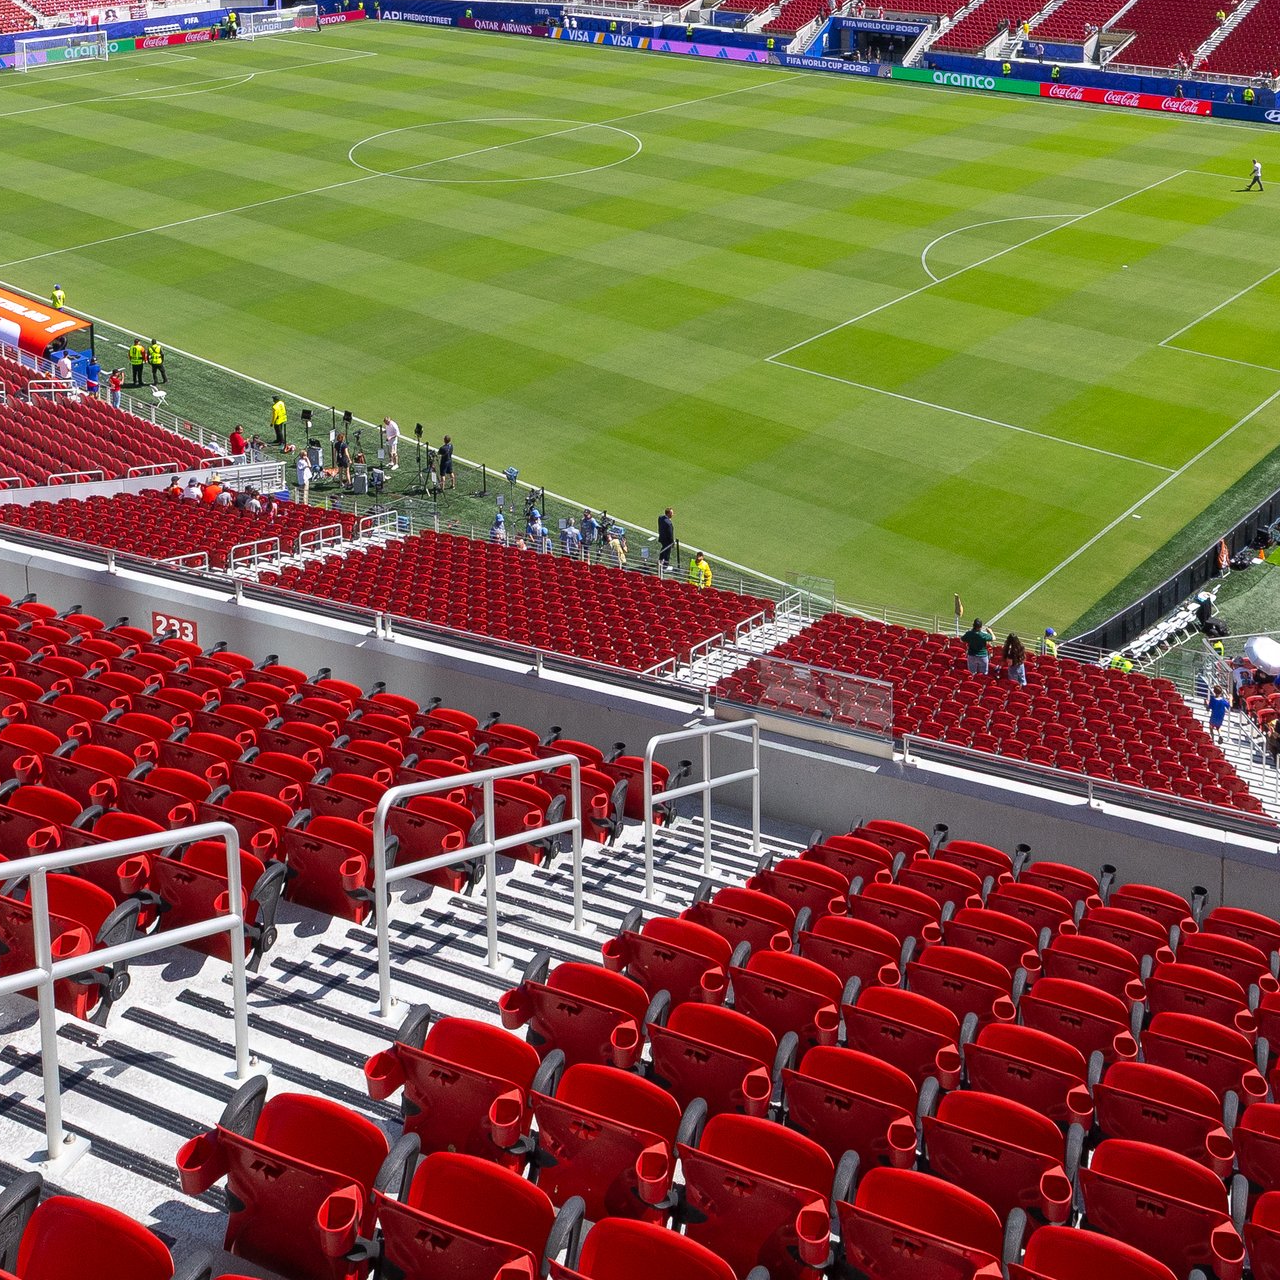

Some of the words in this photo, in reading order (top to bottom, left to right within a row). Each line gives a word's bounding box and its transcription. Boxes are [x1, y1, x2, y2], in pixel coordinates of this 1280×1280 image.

[314, 14, 346, 25] enovo
[383, 10, 401, 20] ADI
[403, 12, 452, 25] PREDICTSTREET
[474, 19, 499, 31] QATAR
[501, 22, 533, 35] AIRWAYS
[842, 19, 856, 28] FIFA
[857, 20, 880, 30] WORLD
[881, 22, 895, 32] CUP
[895, 24, 920, 34] 2026
[143, 37, 169, 48] Coca-Cola
[185, 32, 210, 42] Coca-Cola
[568, 29, 589, 42] VISA
[610, 34, 633, 47] VISA
[64, 42, 119, 59] aramco
[786, 56, 801, 66] FIFA
[802, 58, 826, 68] WORLD
[827, 60, 841, 70] CUP
[843, 62, 867, 73] 2026
[933, 71, 995, 89] aramco
[1049, 84, 1083, 101] Coca-Cola
[1104, 91, 1139, 107] Coca-Cola
[1161, 97, 1199, 114] Coca-Cola
[155, 615, 194, 642] 233
